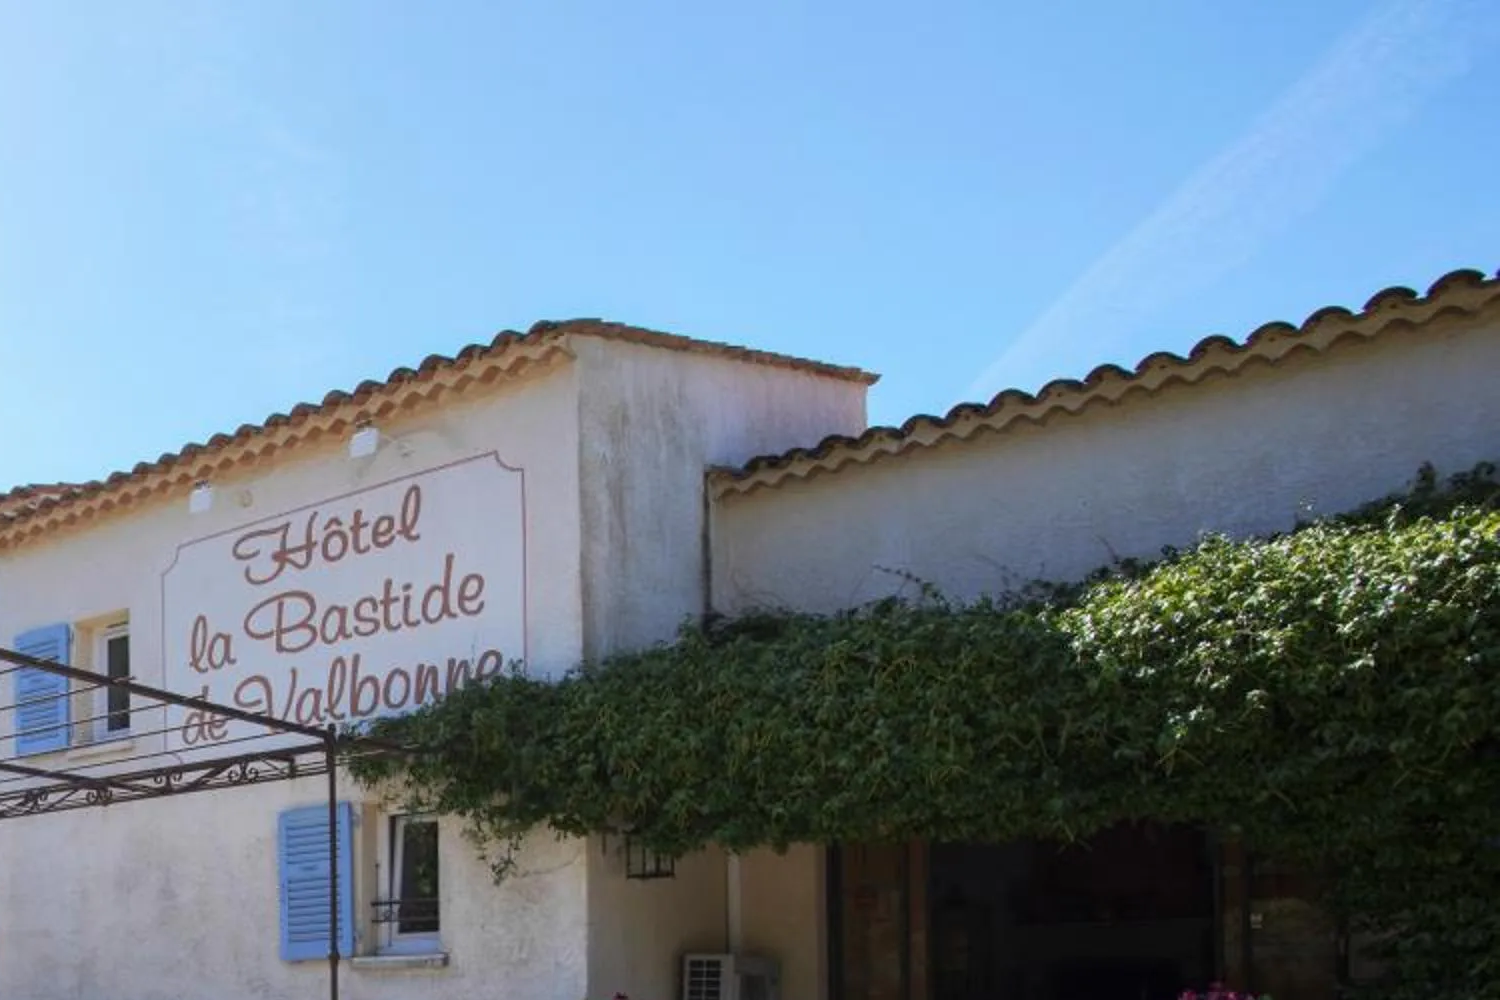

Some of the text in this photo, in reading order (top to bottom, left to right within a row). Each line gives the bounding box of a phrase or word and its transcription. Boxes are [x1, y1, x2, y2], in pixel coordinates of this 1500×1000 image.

[232, 485, 422, 585] Hôtel
[189, 553, 485, 673] la Bastide
[182, 685, 228, 745] de
